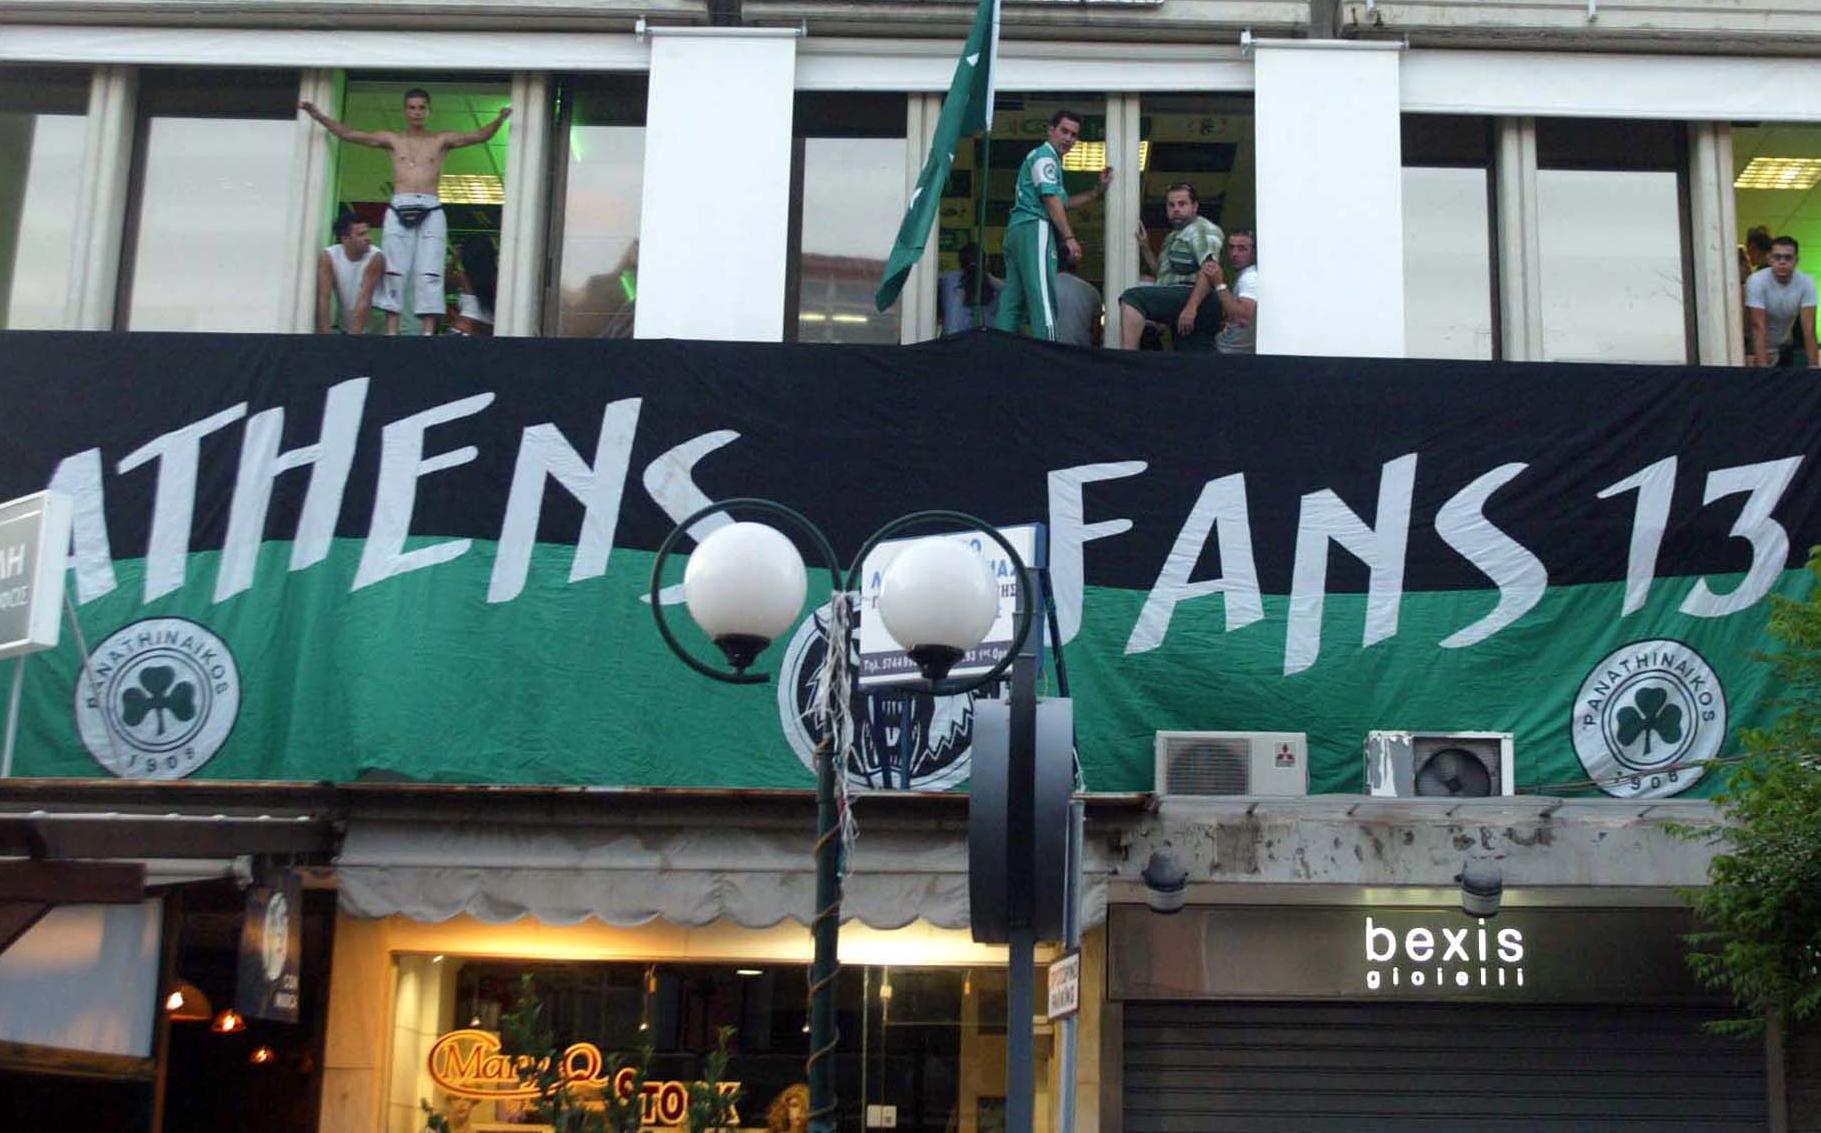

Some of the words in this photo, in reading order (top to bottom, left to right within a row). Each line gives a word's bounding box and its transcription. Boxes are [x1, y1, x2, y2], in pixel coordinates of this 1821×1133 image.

[1043, 452, 1549, 677] FANS
[1597, 455, 1806, 617] 13
[1583, 652, 1716, 727] PANATHINAIKOS
[1366, 917, 1524, 963] bexis
[1366, 966, 1524, 990] gioielli
